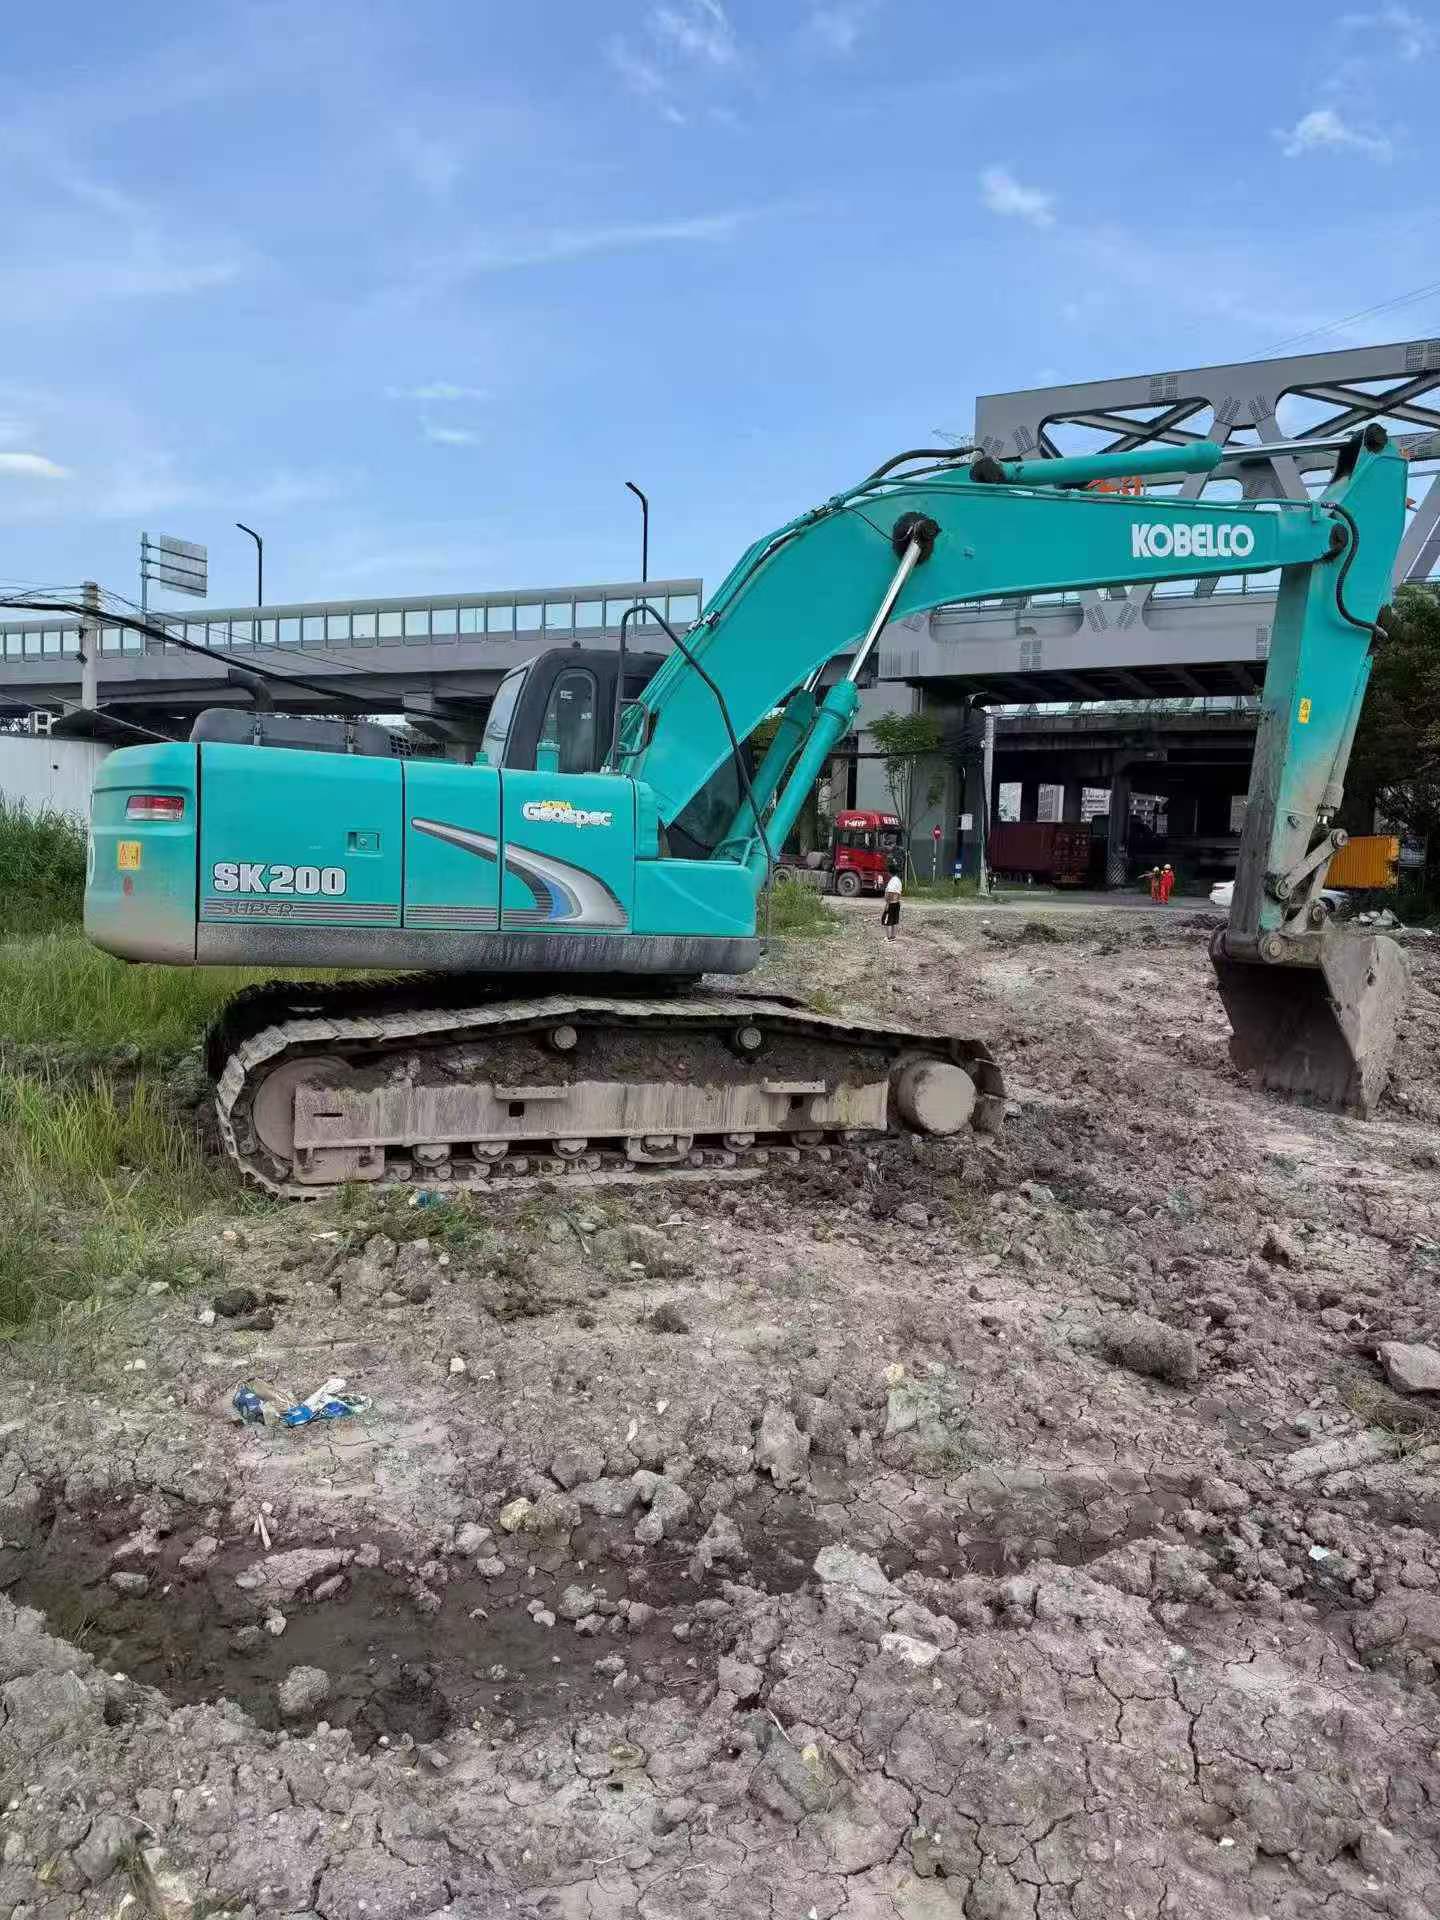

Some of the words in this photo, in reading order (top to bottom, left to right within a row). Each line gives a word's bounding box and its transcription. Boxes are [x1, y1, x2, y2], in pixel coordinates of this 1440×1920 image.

[1131, 523, 1255, 557] KOBELCO
[213, 861, 346, 895] SK200
[222, 901, 296, 918] SUPER
